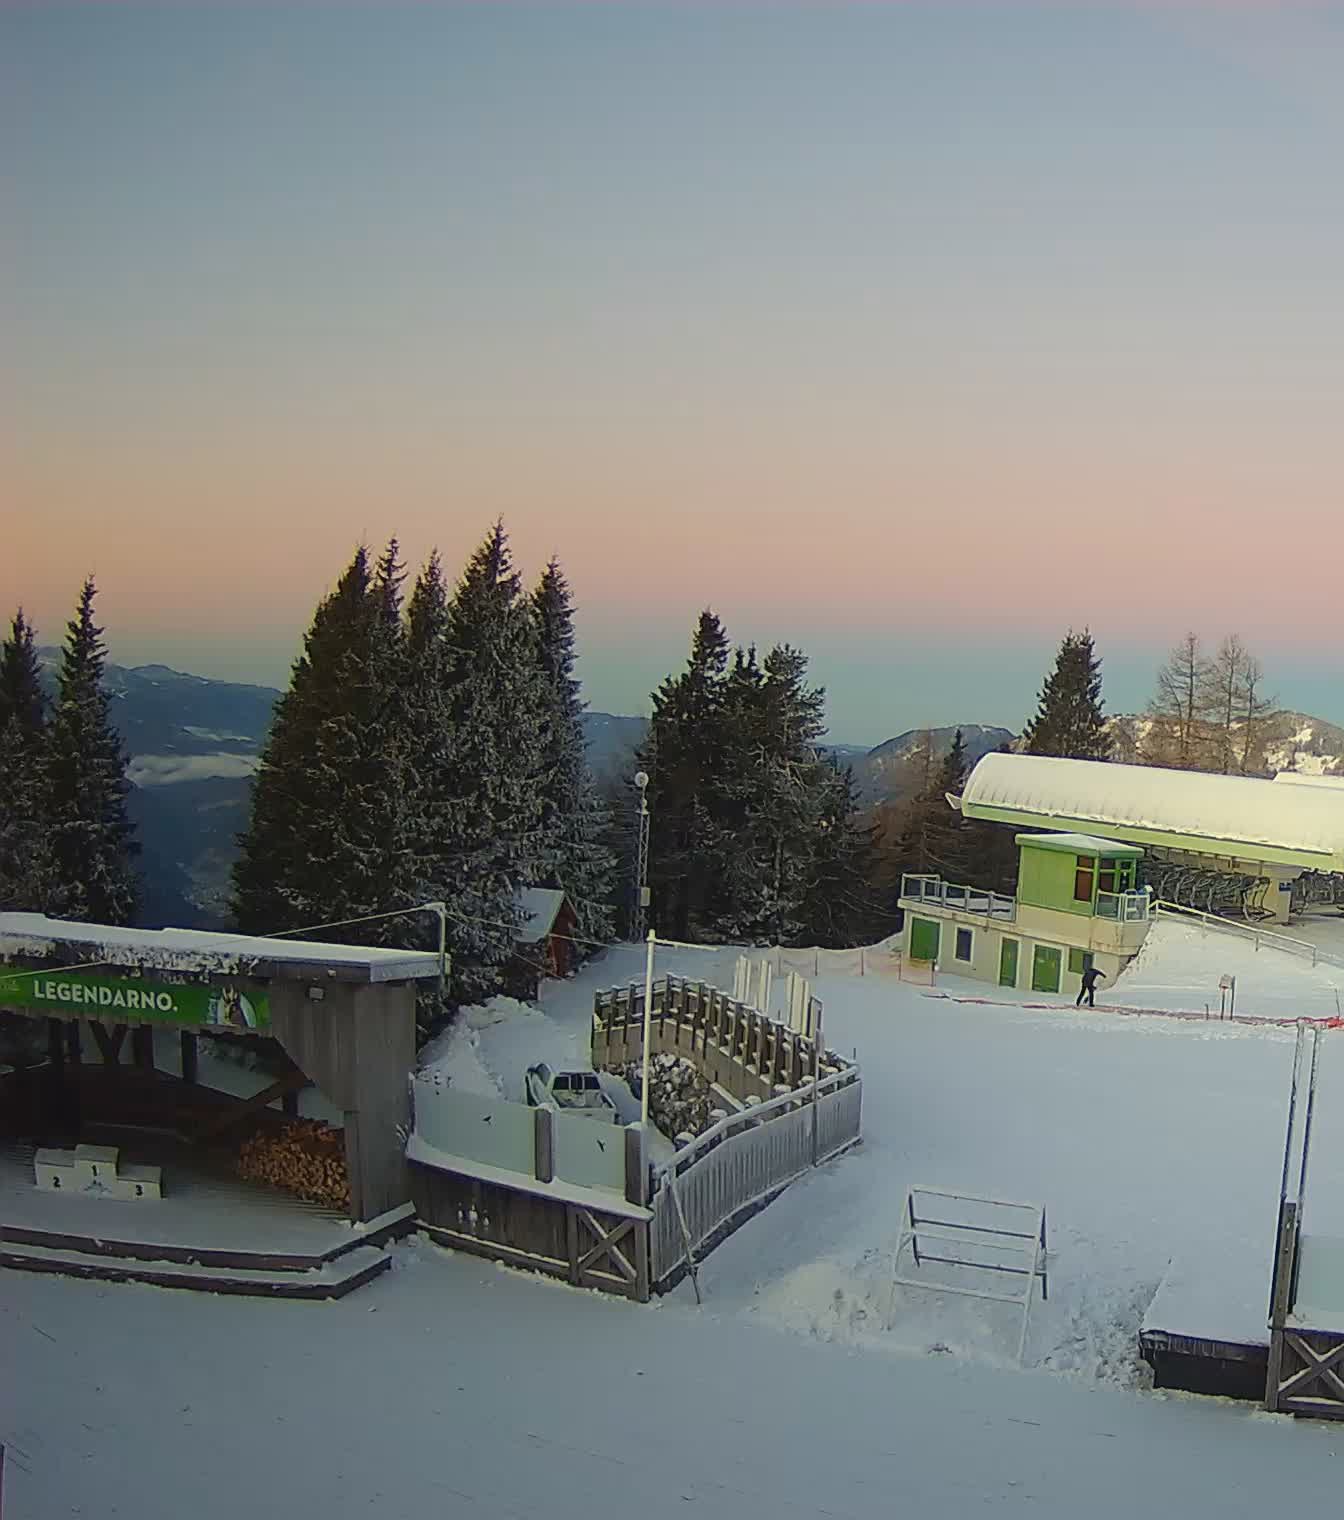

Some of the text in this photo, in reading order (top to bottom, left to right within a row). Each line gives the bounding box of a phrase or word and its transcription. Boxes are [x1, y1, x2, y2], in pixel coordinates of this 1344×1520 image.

[34, 980, 178, 1011] LEGENDARNO.
[92, 1165, 98, 1177] 1
[53, 1176, 61, 1188] 2
[135, 1185, 143, 1196] 3
